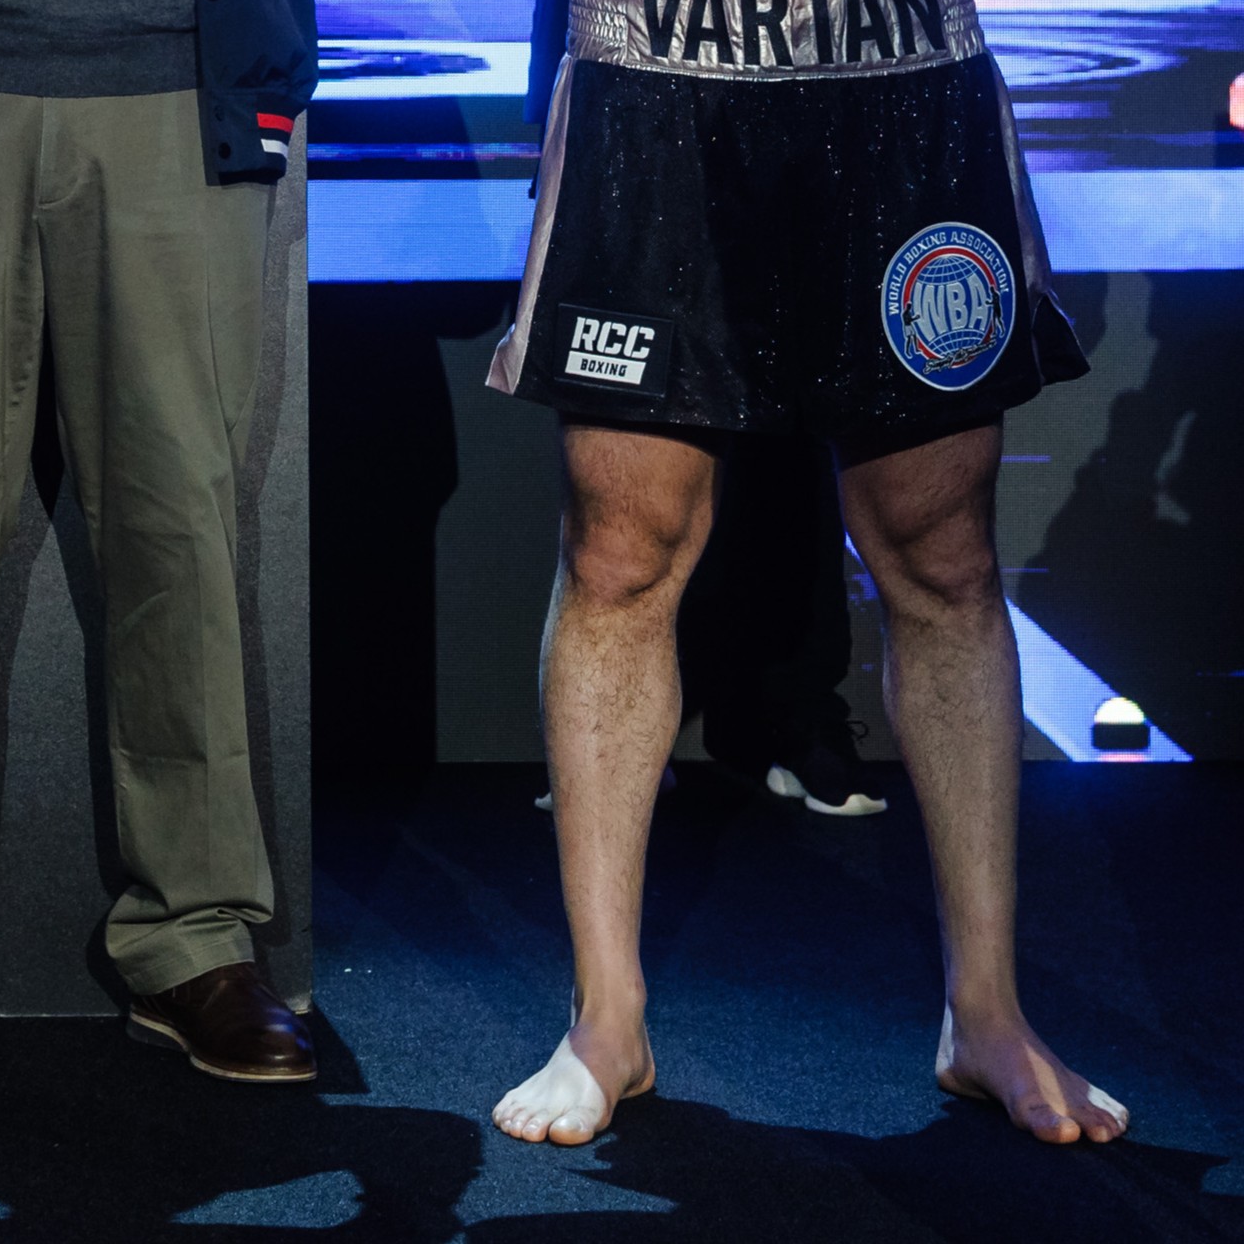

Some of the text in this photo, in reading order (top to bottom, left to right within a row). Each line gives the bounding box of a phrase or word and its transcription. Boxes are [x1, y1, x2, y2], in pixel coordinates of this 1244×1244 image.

[888, 231, 1009, 316] WORLD BOXING ASSOCIATION
[912, 274, 990, 342] WBA
[571, 316, 655, 359] RCC
[580, 358, 628, 377] BOXING
